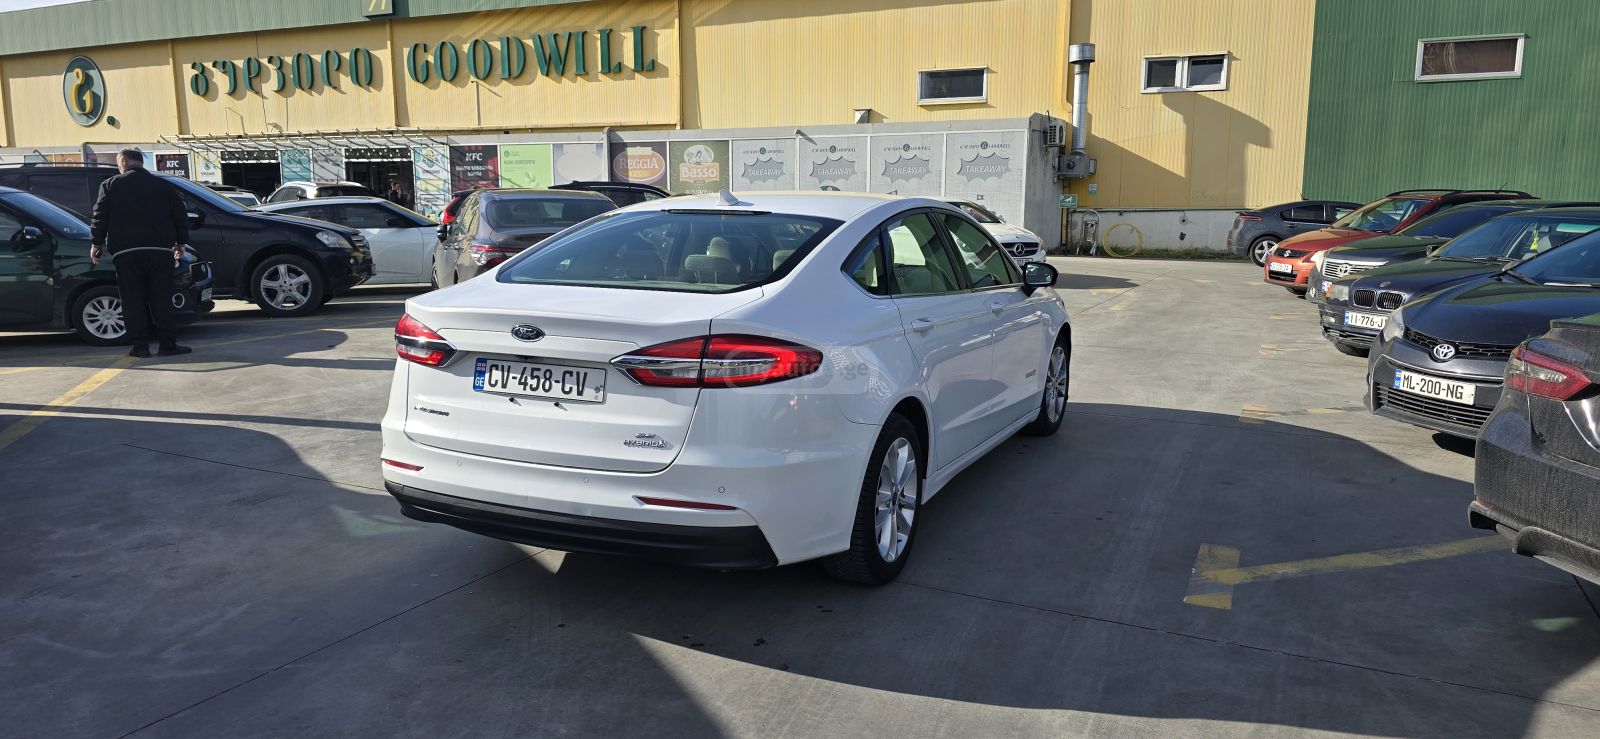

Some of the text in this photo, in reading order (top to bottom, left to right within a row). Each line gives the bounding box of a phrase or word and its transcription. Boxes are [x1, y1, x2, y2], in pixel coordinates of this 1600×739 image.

[406, 25, 656, 84] GOODWILL
[190, 47, 375, 98] გუდვილი
[465, 152, 483, 162] KFC
[166, 160, 180, 168] KFC
[681, 166, 717, 178] Basso
[747, 168, 783, 176] TAKEAWAY
[817, 167, 854, 176] TAKEAWAY
[889, 166, 928, 175] TAKEAWAY
[964, 165, 1008, 174] TAKEAWAY
[1350, 314, 1384, 328] II-776-J
[474, 363, 588, 397] GE CV-458-CV
[1402, 374, 1464, 400] ML-200-NG
[623, 439, 659, 448] HYBRID
